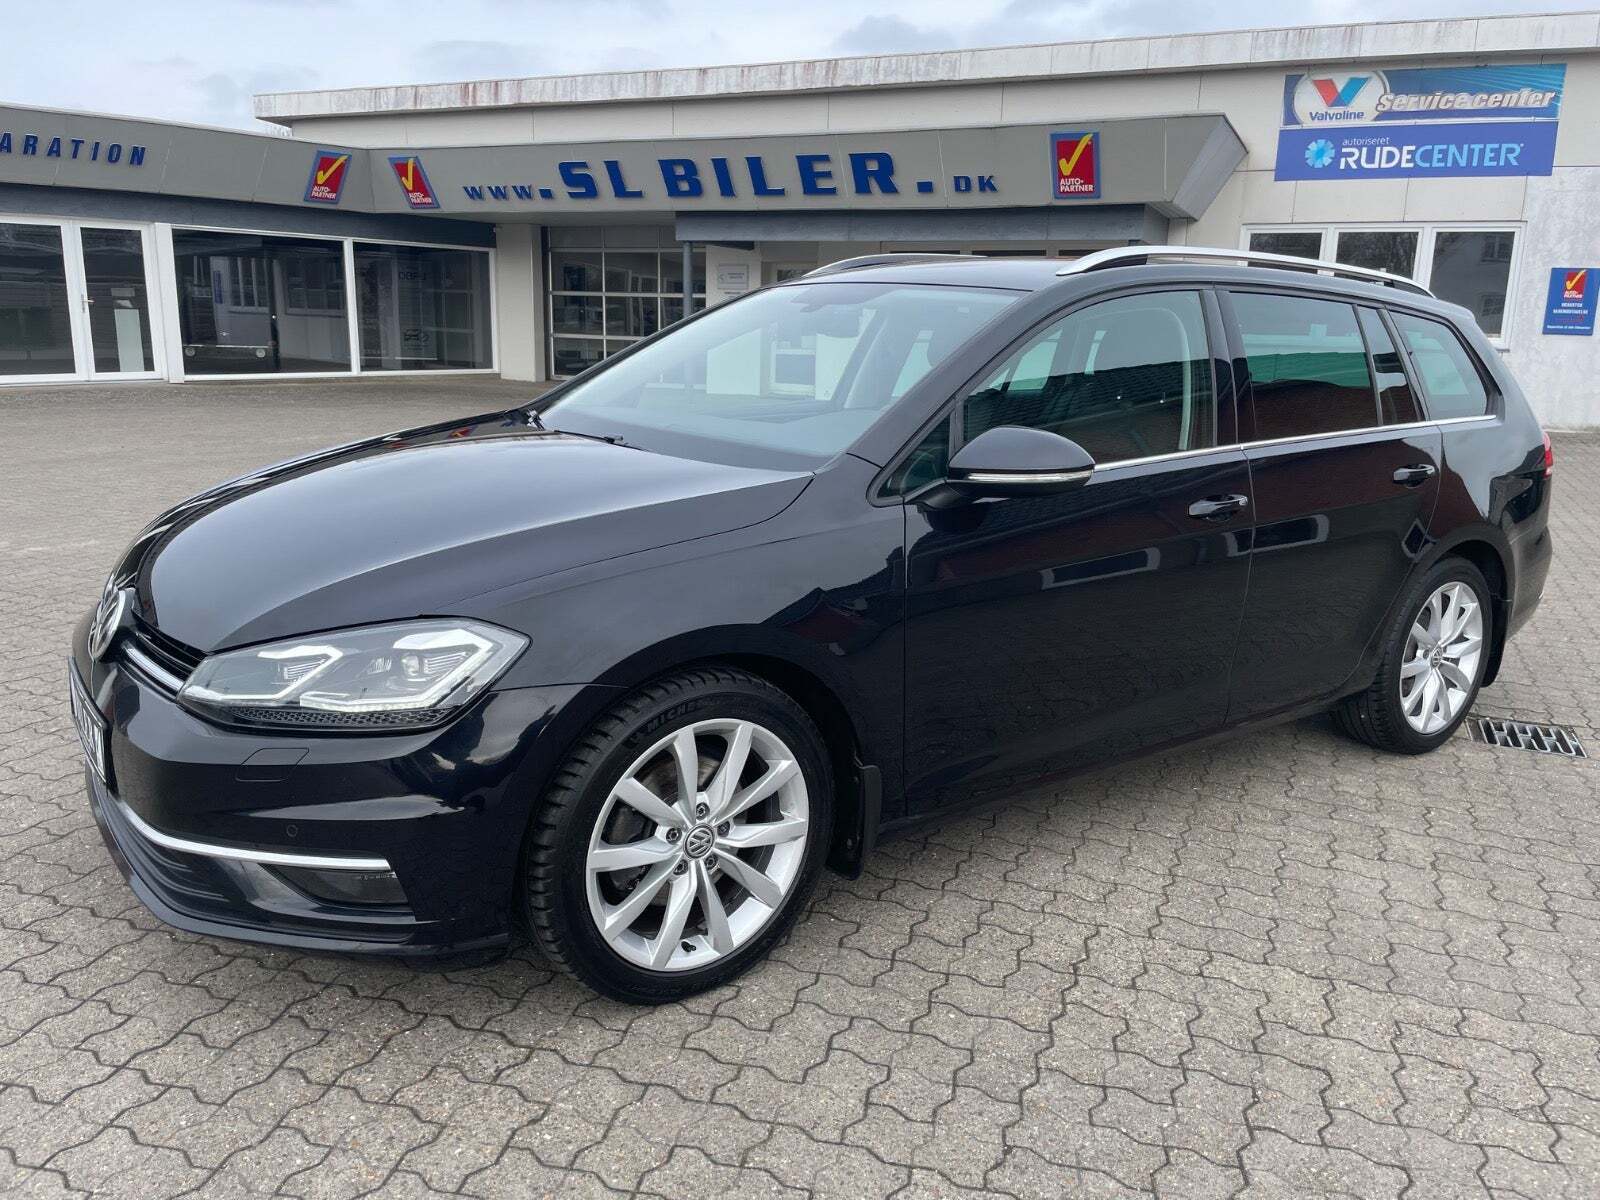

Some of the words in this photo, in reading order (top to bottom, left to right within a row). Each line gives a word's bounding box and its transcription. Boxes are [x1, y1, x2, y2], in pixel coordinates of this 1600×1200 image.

[1377, 91, 1473, 111] Service
[1473, 87, 1556, 109] center
[1309, 110, 1365, 121] Valvoline
[1342, 137, 1390, 146] autoriseret
[0, 132, 147, 166] ARATION
[1060, 178, 1084, 186] AUTO-
[311, 192, 337, 200] PARTNER
